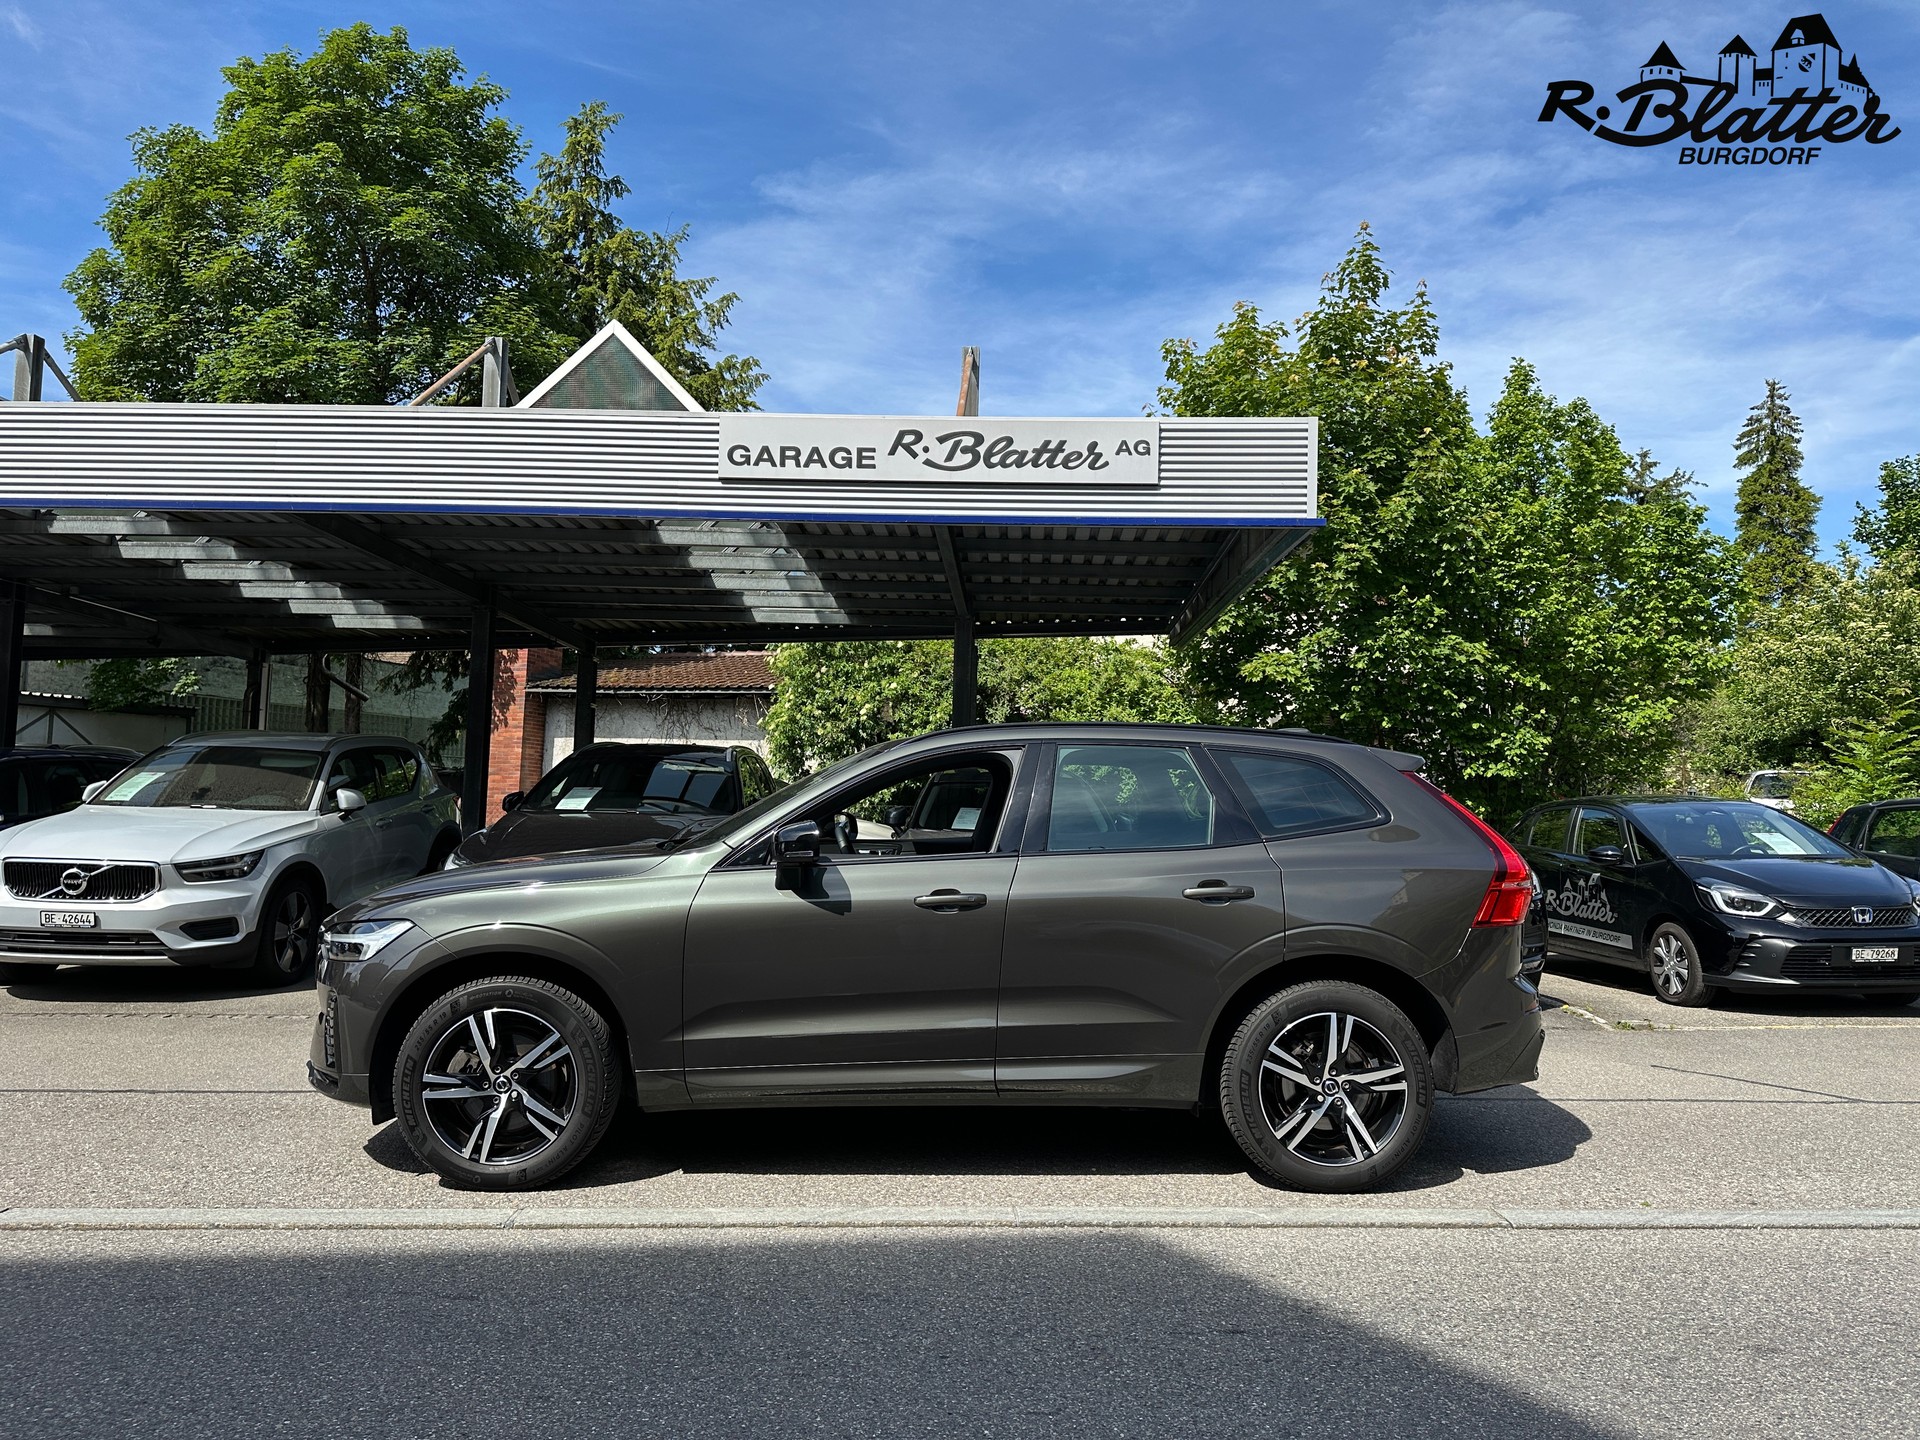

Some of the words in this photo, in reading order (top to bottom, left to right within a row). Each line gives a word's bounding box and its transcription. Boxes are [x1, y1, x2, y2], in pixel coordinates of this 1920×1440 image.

[727, 444, 877, 470] GARAGE
[1115, 439, 1151, 457] AG
[402, 1060, 417, 1126] MICHELIN
[582, 1046, 597, 1115] MICHELIN
[1404, 1040, 1426, 1106] MICHELIN
[1241, 1072, 1261, 1142] MICHELIN
